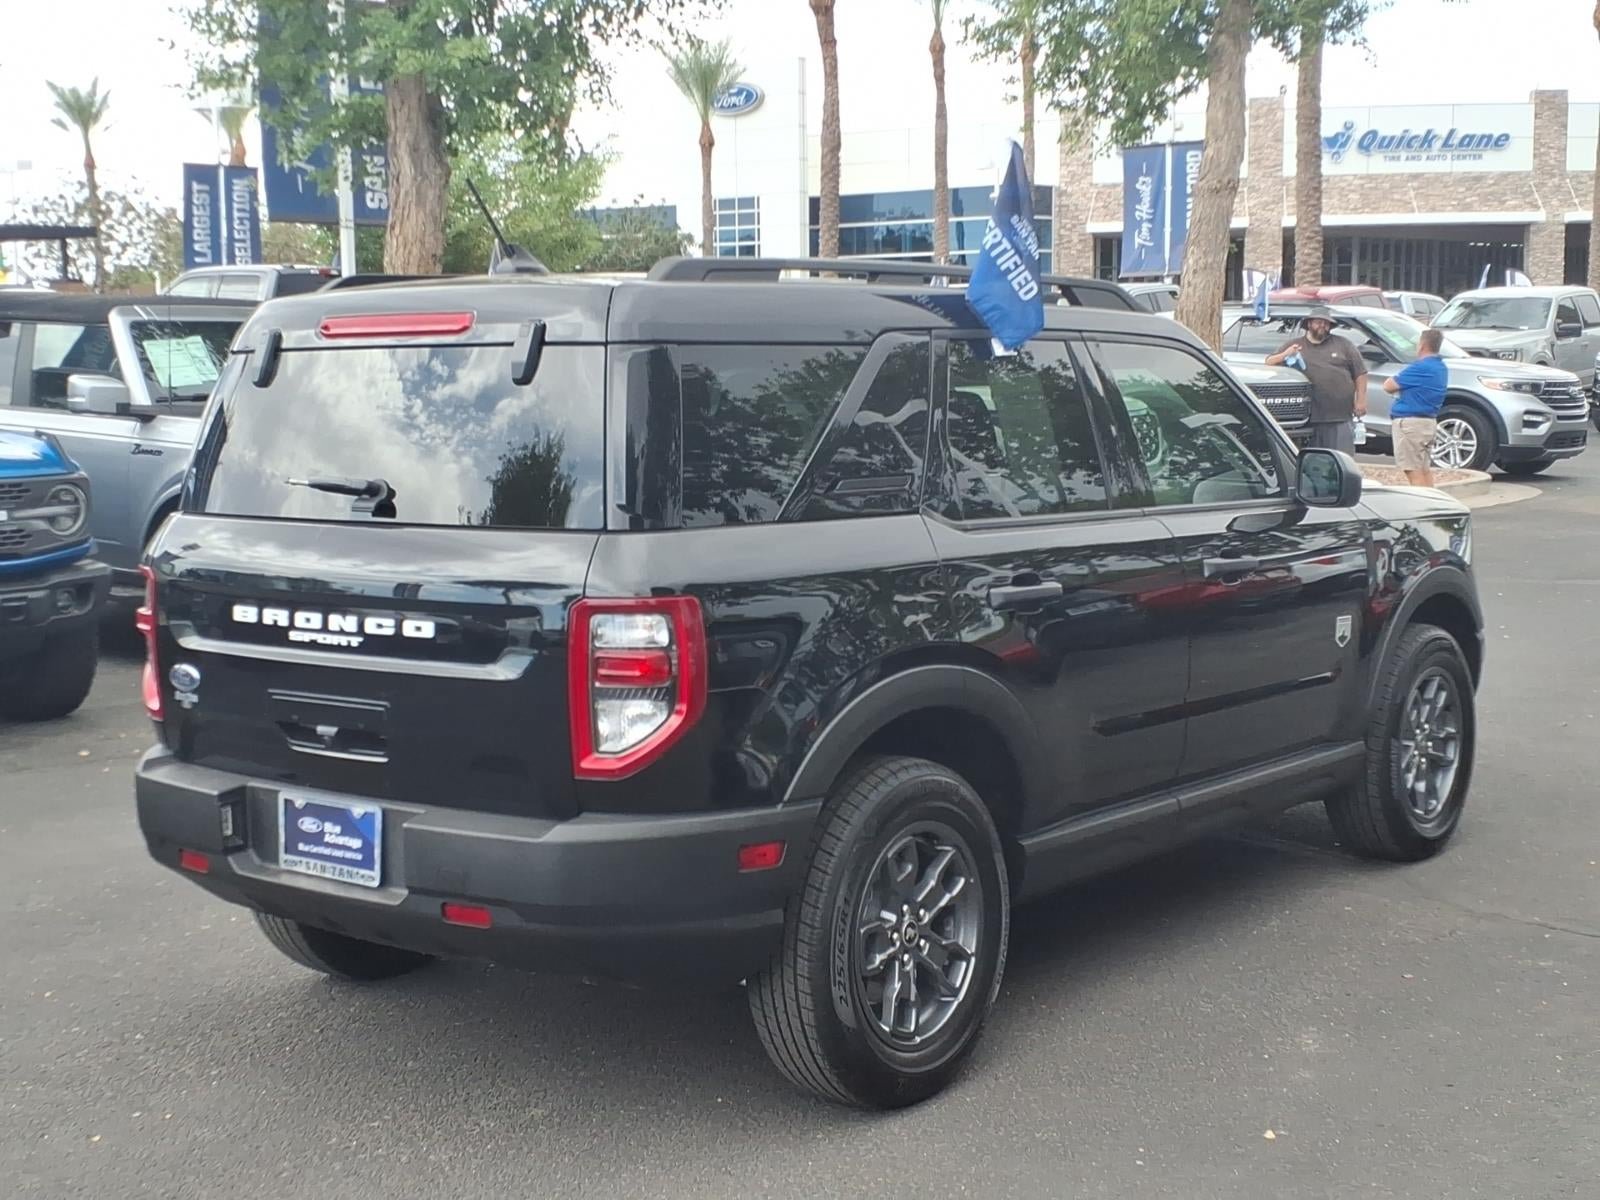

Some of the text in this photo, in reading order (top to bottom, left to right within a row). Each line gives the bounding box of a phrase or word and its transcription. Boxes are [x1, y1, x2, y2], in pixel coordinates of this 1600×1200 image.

[714, 88, 748, 108] Ford
[1357, 128, 1510, 155] Quick Lane
[1384, 153, 1483, 162] TIRE AND AUTO CENTER
[191, 181, 212, 264] LARGEST
[231, 179, 252, 265] SELECTION
[981, 217, 1041, 303] ERTIFIED
[232, 604, 436, 639] BRONCO
[288, 630, 364, 647] SPORT
[836, 891, 851, 1007] 225/65R1
